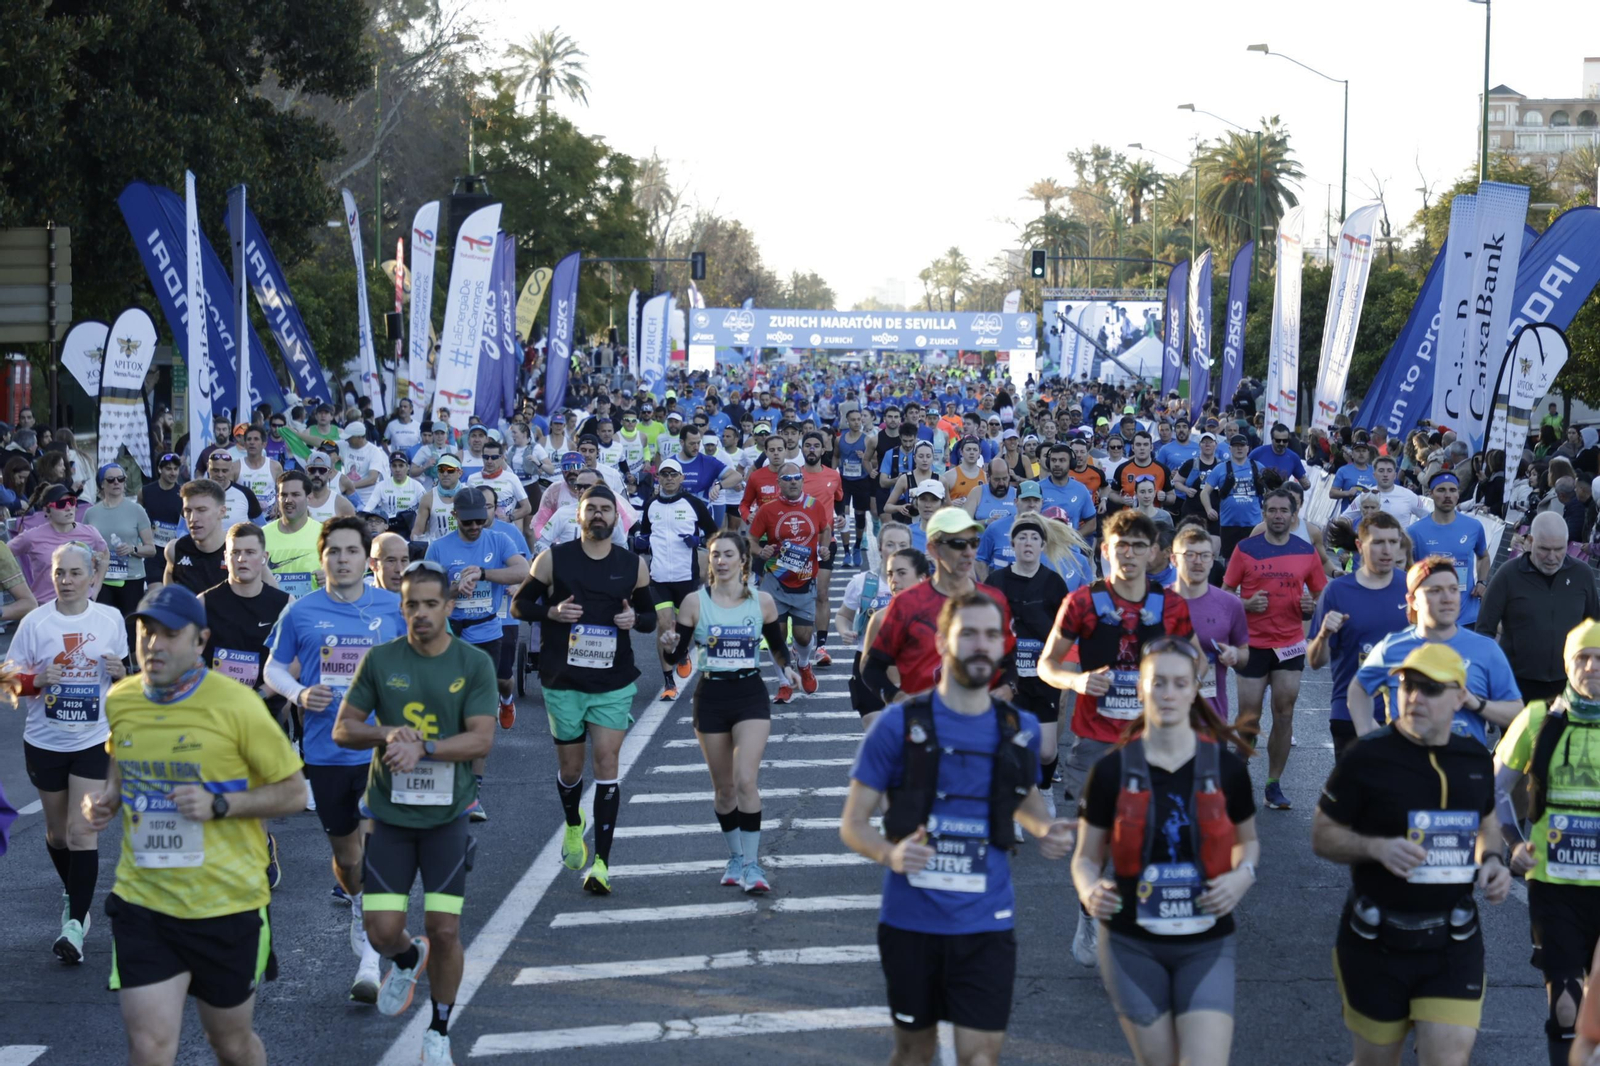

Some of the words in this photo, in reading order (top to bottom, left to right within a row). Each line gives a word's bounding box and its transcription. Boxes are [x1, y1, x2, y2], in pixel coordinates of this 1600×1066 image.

[466, 280, 485, 349] LasCarreras
[482, 290, 497, 337] asics
[556, 300, 568, 340] asics
[769, 315, 818, 328] ZURICH
[821, 314, 883, 329] MARATÓN
[886, 318, 902, 330] DE
[905, 318, 957, 330] SEVILLA
[1227, 300, 1243, 343] asics
[1169, 308, 1180, 348] asics
[1470, 232, 1506, 421] CaixaBank
[646, 317, 658, 364] ZURICH
[824, 336, 853, 345] ZURICH
[929, 338, 959, 346] ZURICH
[114, 360, 143, 371] APITOX
[1400, 365, 1420, 393] to
[724, 627, 751, 635] ZURICH
[341, 638, 374, 646] ZURICH
[568, 647, 614, 660] CASCARILLA
[716, 648, 746, 658] LAURA
[1015, 659, 1036, 668] AURA
[228, 666, 244, 674] 9453
[65, 687, 94, 695] ZURICH
[62, 701, 83, 709] 14124
[1105, 696, 1143, 708] MIGUEL
[56, 709, 88, 721] SILVIA
[406, 778, 435, 790] LEMI
[150, 820, 177, 830] 10742
[941, 818, 985, 834] ZURICH
[1434, 815, 1474, 827] ZURICH
[1572, 819, 1600, 831] ZURIC
[144, 835, 183, 850] JULIO
[1570, 837, 1597, 849] 13118
[1425, 850, 1471, 866] OHNNY
[926, 855, 973, 874] STEVE
[1163, 867, 1198, 879] ZURIC
[1159, 901, 1193, 918] SAM
